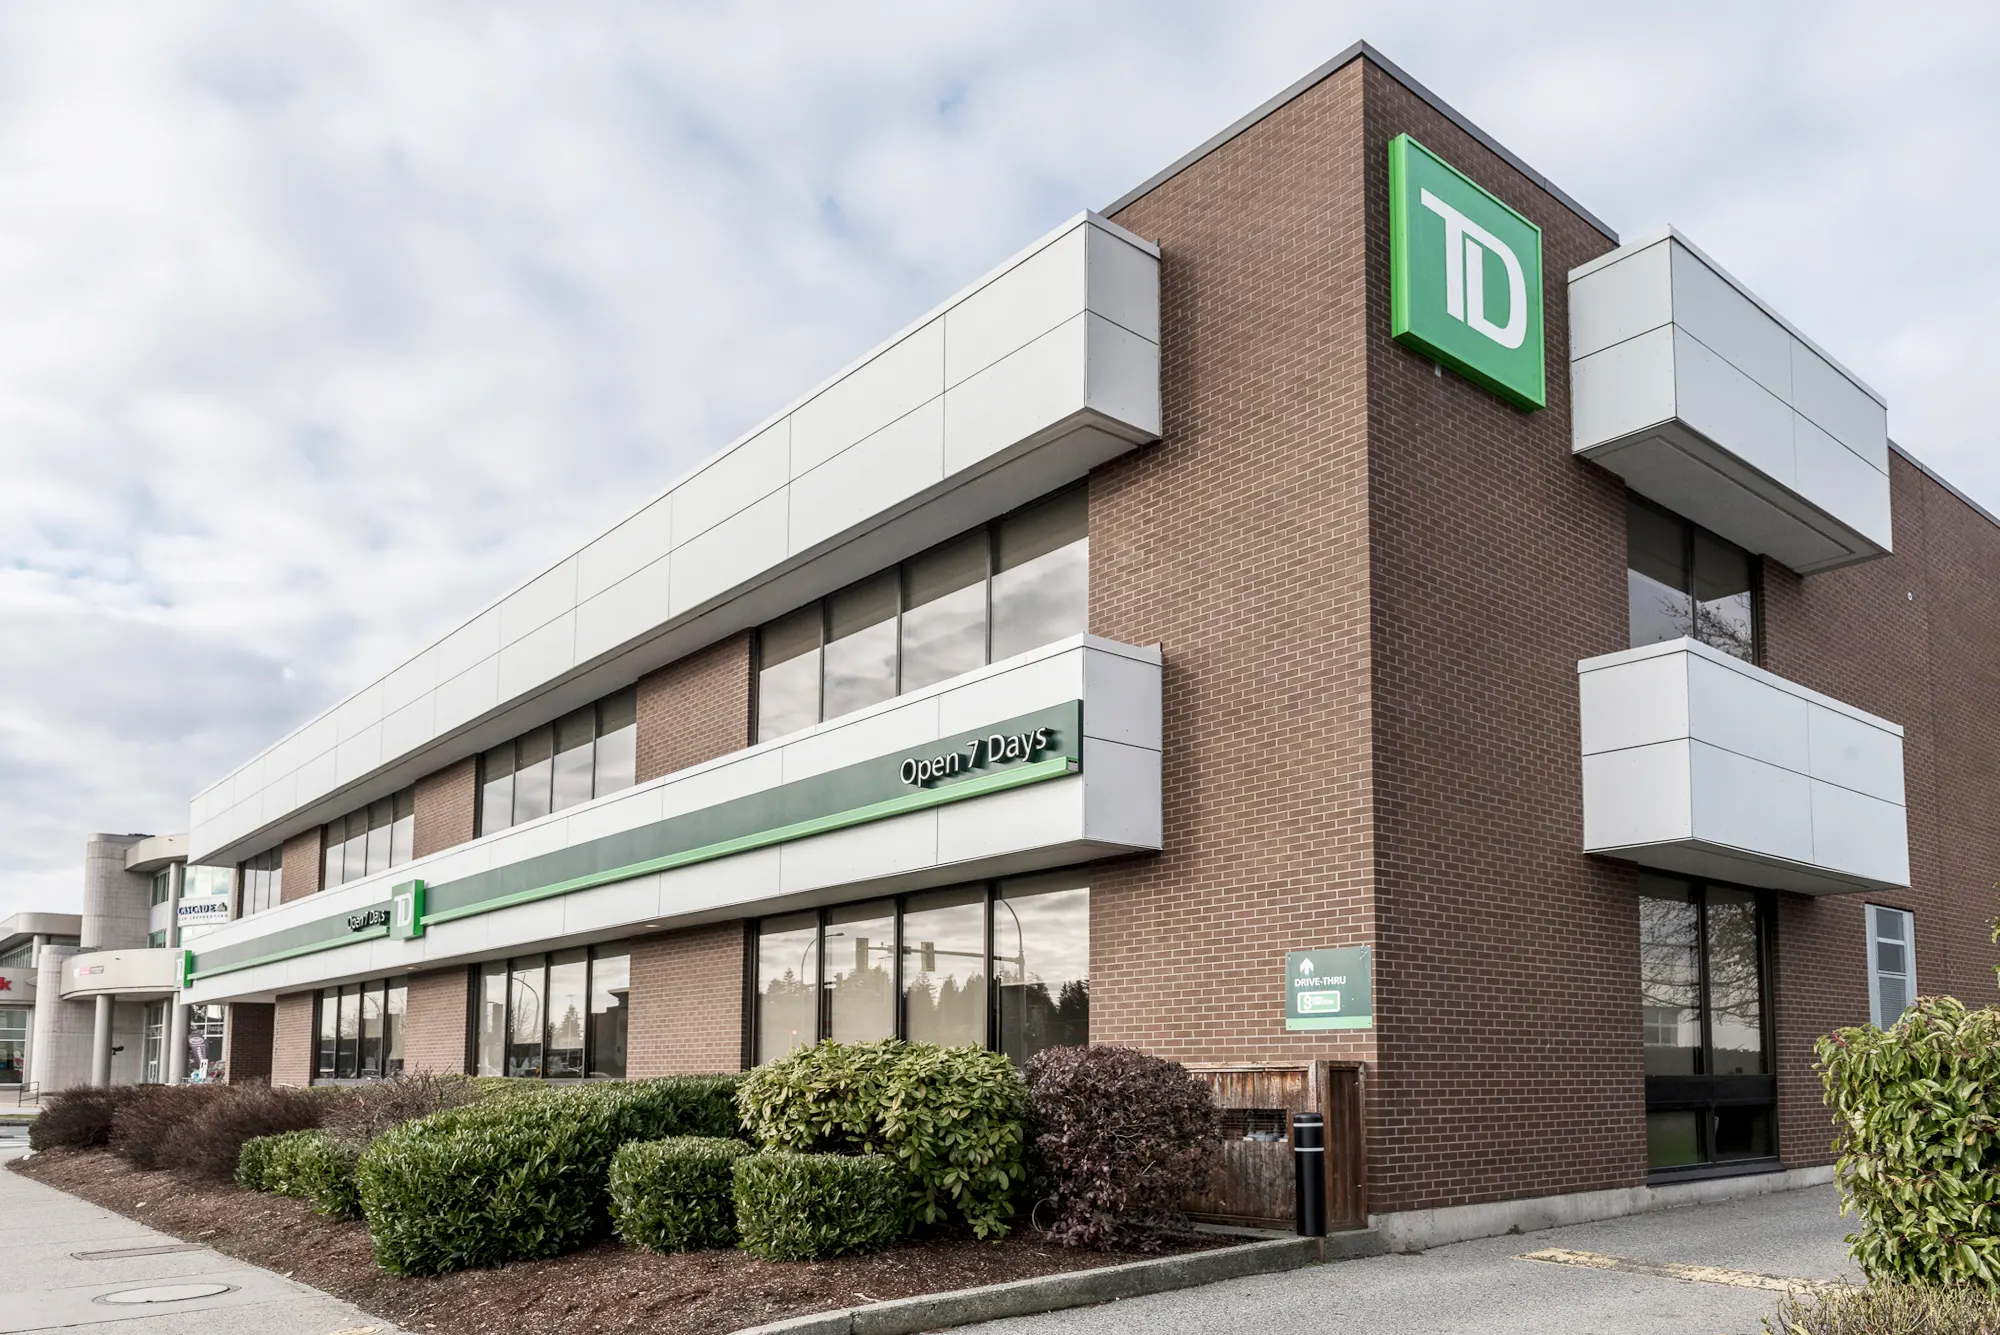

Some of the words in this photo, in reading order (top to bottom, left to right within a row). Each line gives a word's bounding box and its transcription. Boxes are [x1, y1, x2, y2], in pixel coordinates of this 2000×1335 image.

[1421, 187, 1527, 350] TD
[899, 751, 959, 788] Open
[965, 739, 980, 768] 7
[987, 727, 1048, 762] Days
[393, 892, 412, 927] TD
[1294, 975, 1347, 988] DRIVE-THRU
